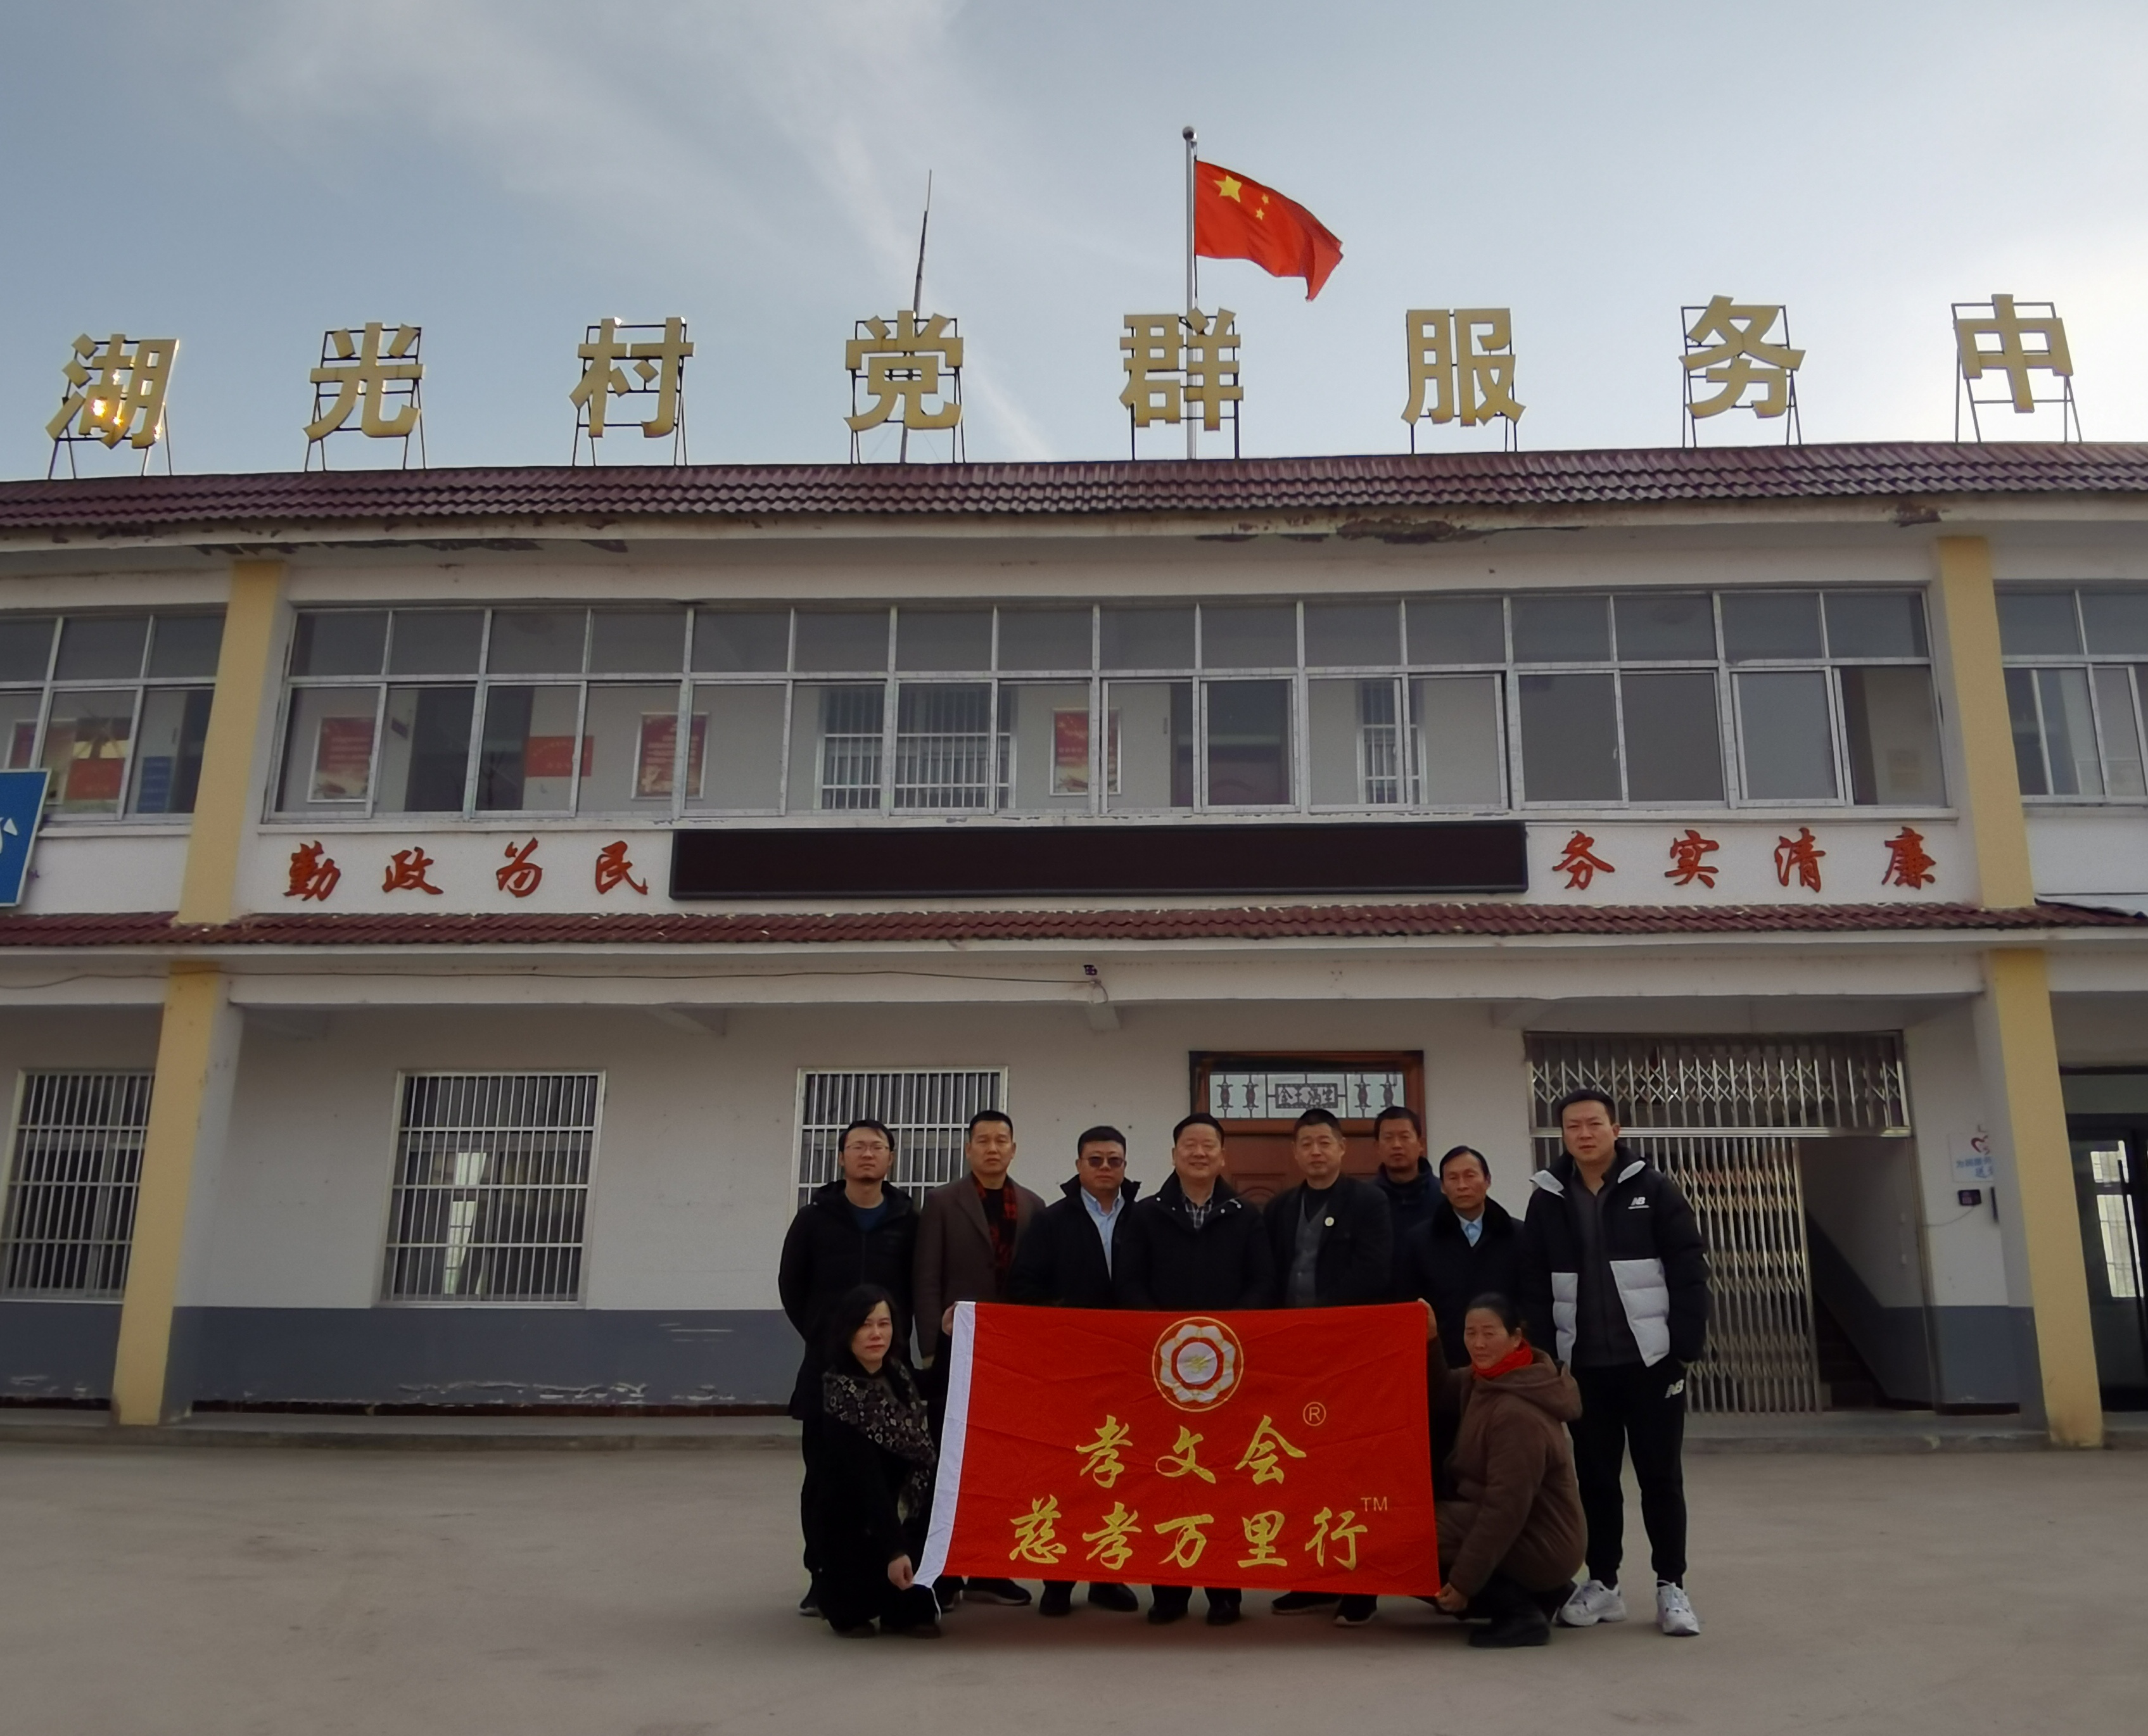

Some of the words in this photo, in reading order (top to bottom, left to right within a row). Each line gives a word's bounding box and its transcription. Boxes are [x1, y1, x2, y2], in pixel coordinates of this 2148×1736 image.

[46, 294, 2074, 448] 湖光村党群服务中
[283, 837, 648, 902] 勤政为民
[1553, 827, 1936, 892] 务实清廉
[1076, 1414, 1307, 1488] 孝文会
[1009, 1494, 1368, 1571] 慈孝万里行
[1361, 1497, 1387, 1512] TM
